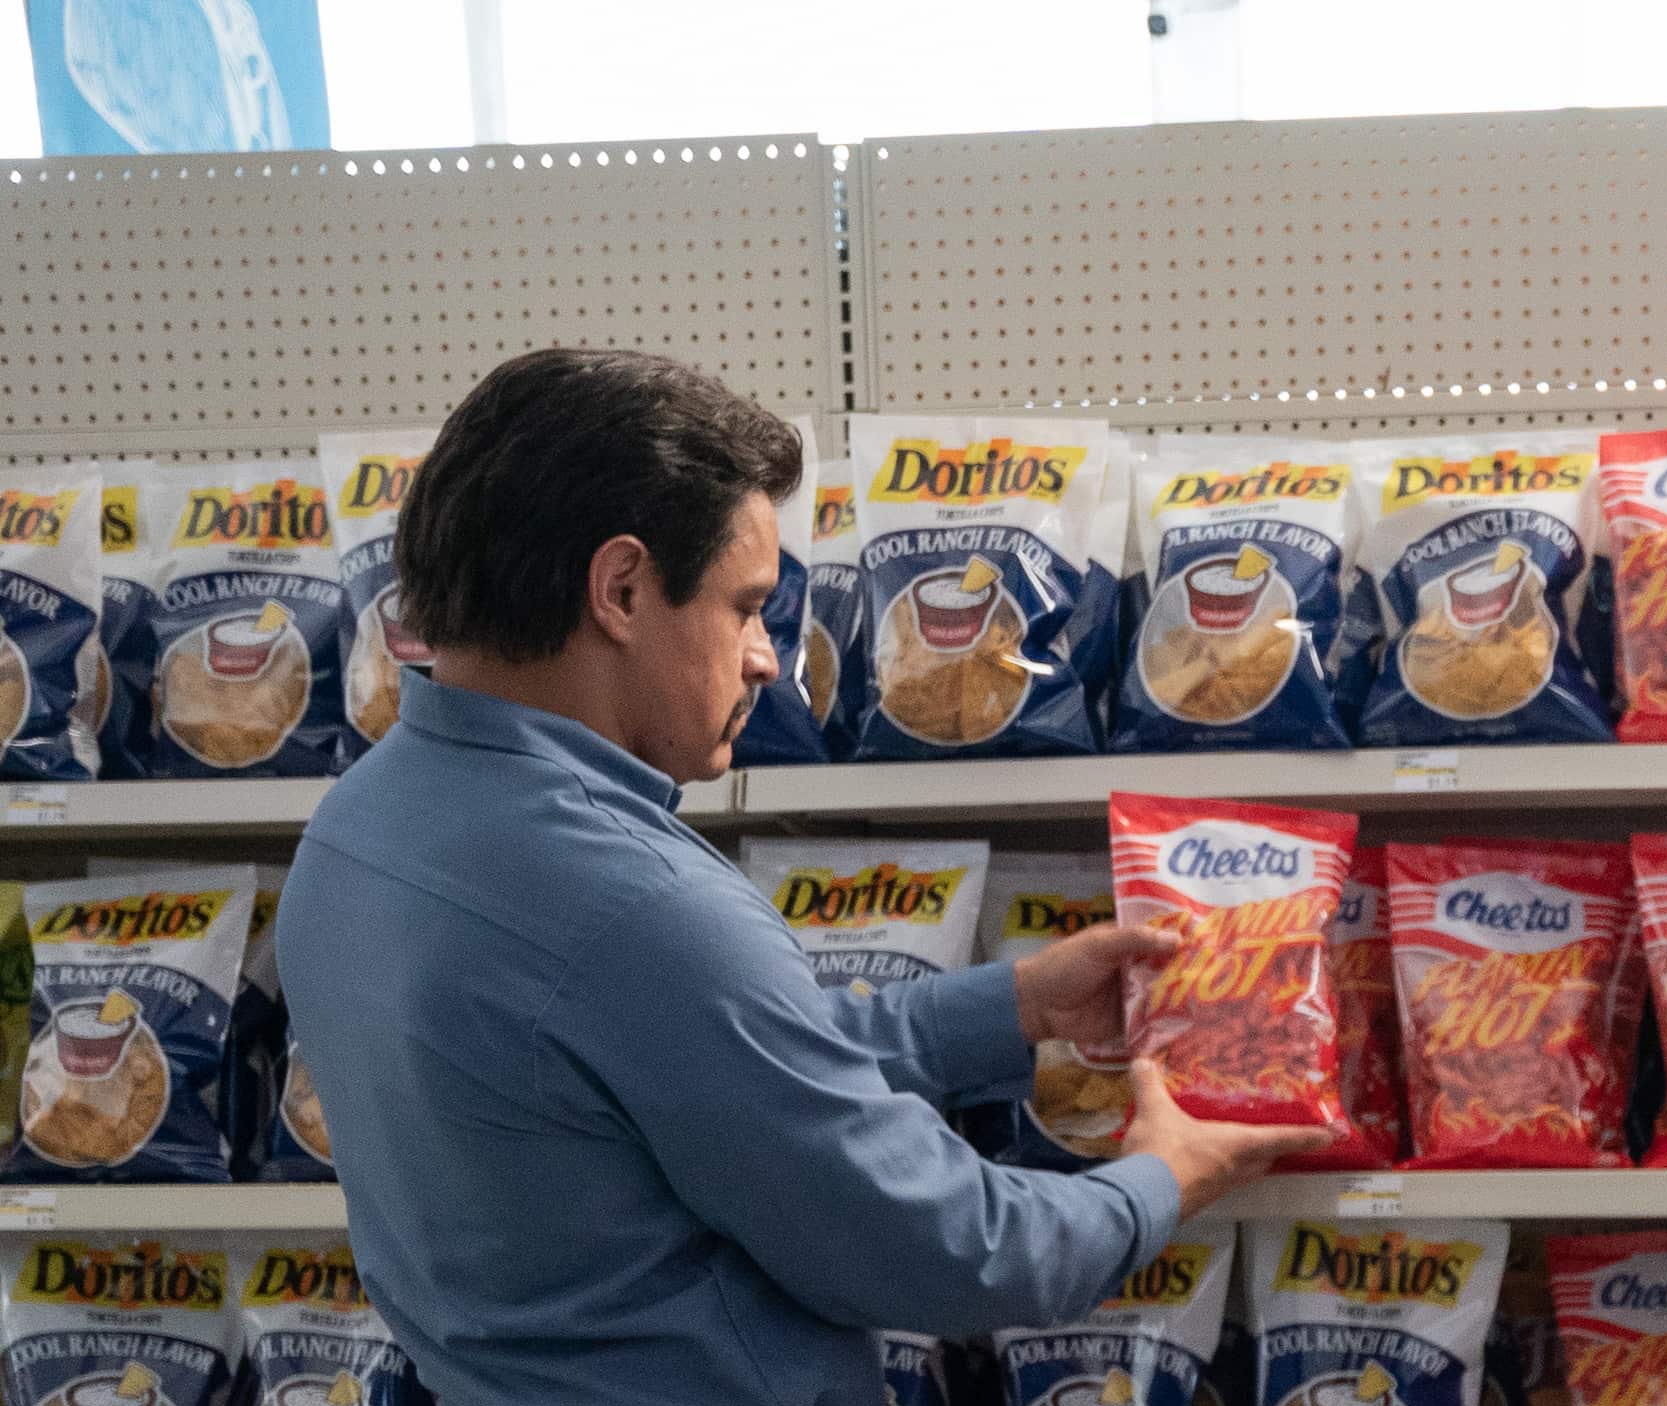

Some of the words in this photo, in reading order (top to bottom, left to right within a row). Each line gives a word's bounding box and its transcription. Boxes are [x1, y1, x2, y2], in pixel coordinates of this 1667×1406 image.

[887, 446, 1067, 499] Doritos
[1170, 466, 1346, 502] Doritos
[1397, 460, 1582, 497] Doritos
[185, 490, 330, 541] Dorito
[865, 535, 916, 570] COOL
[918, 529, 982, 553] RANCH
[986, 529, 1053, 577] FLAVOR
[44, 893, 210, 938] Doritos
[782, 865, 948, 922] Doritos
[868, 955, 931, 983] FLAVO
[1150, 932, 1324, 1012] HOT
[32, 1244, 222, 1302] Doritos
[1289, 1226, 1463, 1297] Doritos
[68, 1333, 139, 1356] RANCH
